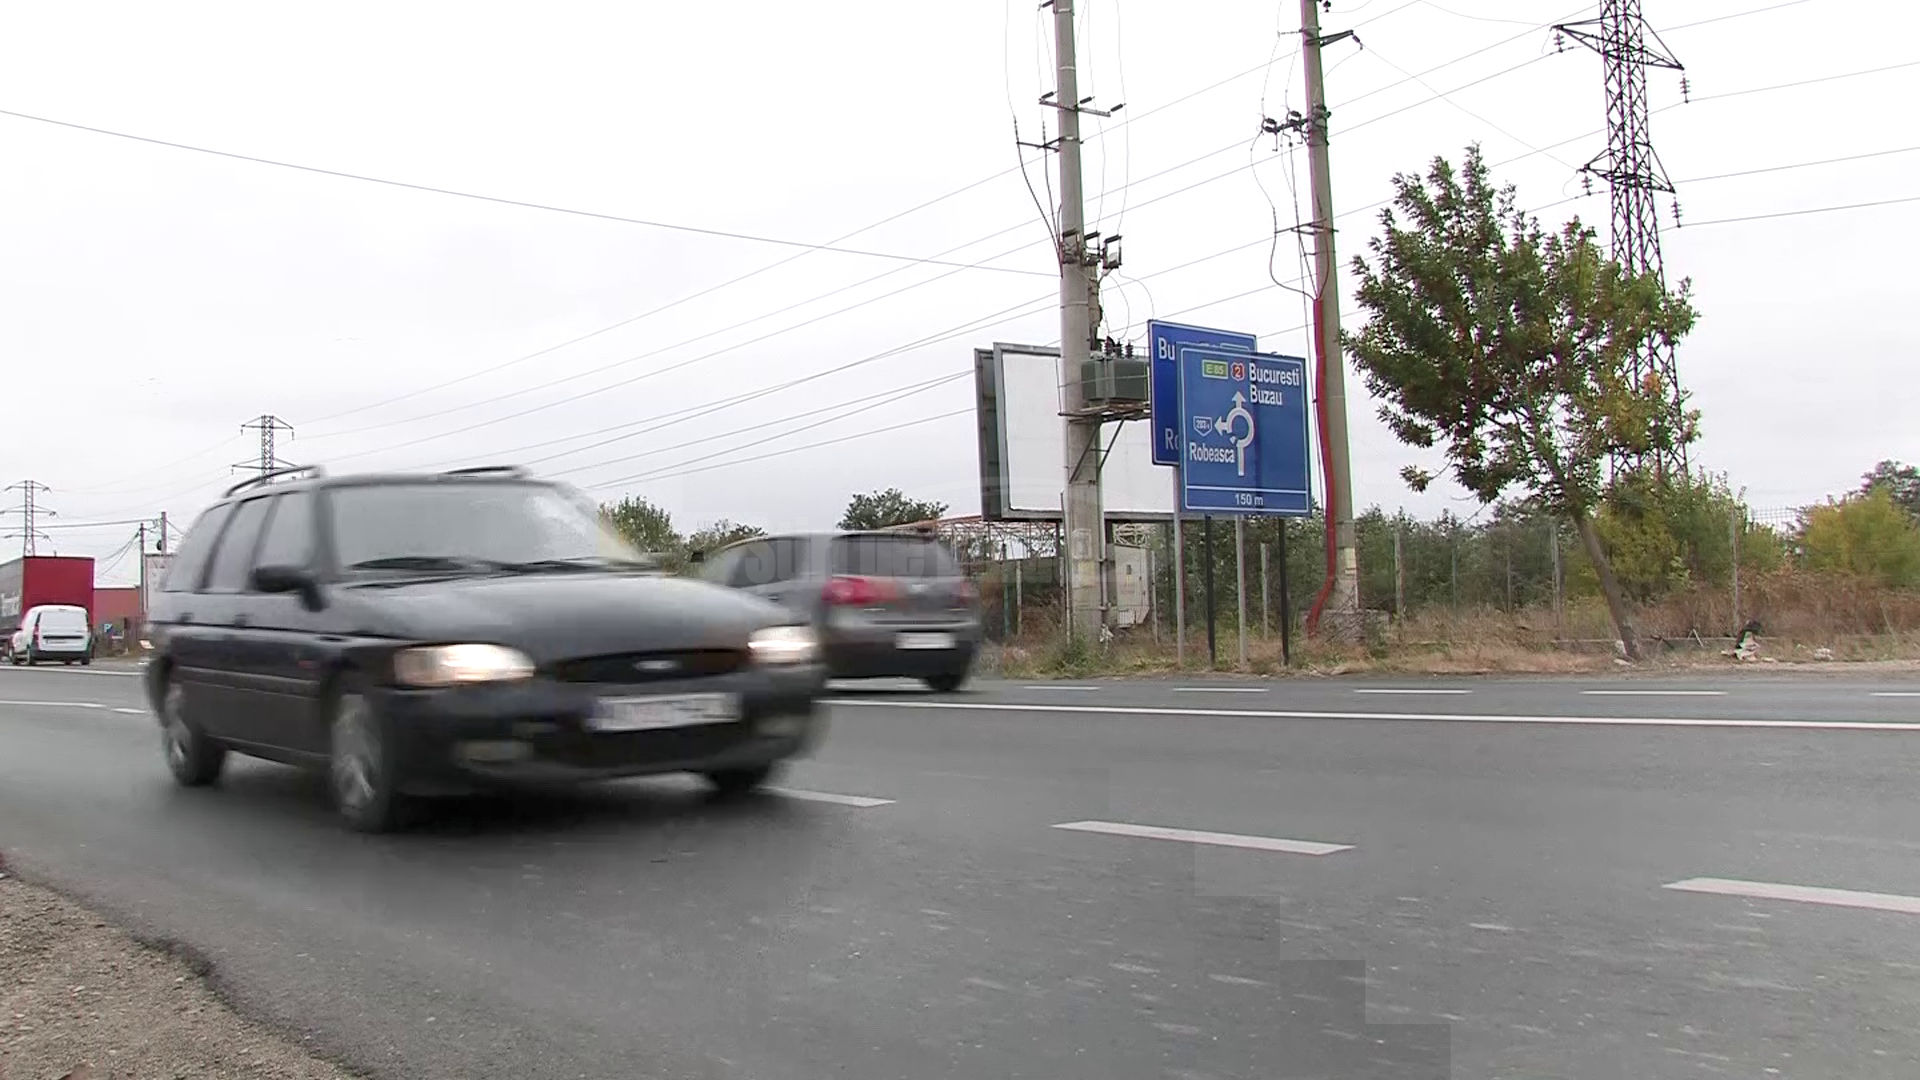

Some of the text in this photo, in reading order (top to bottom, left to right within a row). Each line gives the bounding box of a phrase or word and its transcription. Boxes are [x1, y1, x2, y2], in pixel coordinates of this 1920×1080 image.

[1249, 362, 1300, 386] Bucuresti
[1250, 384, 1283, 406] Buzau
[1189, 441, 1235, 464] Robeasca
[1235, 493, 1264, 506] 150 m
